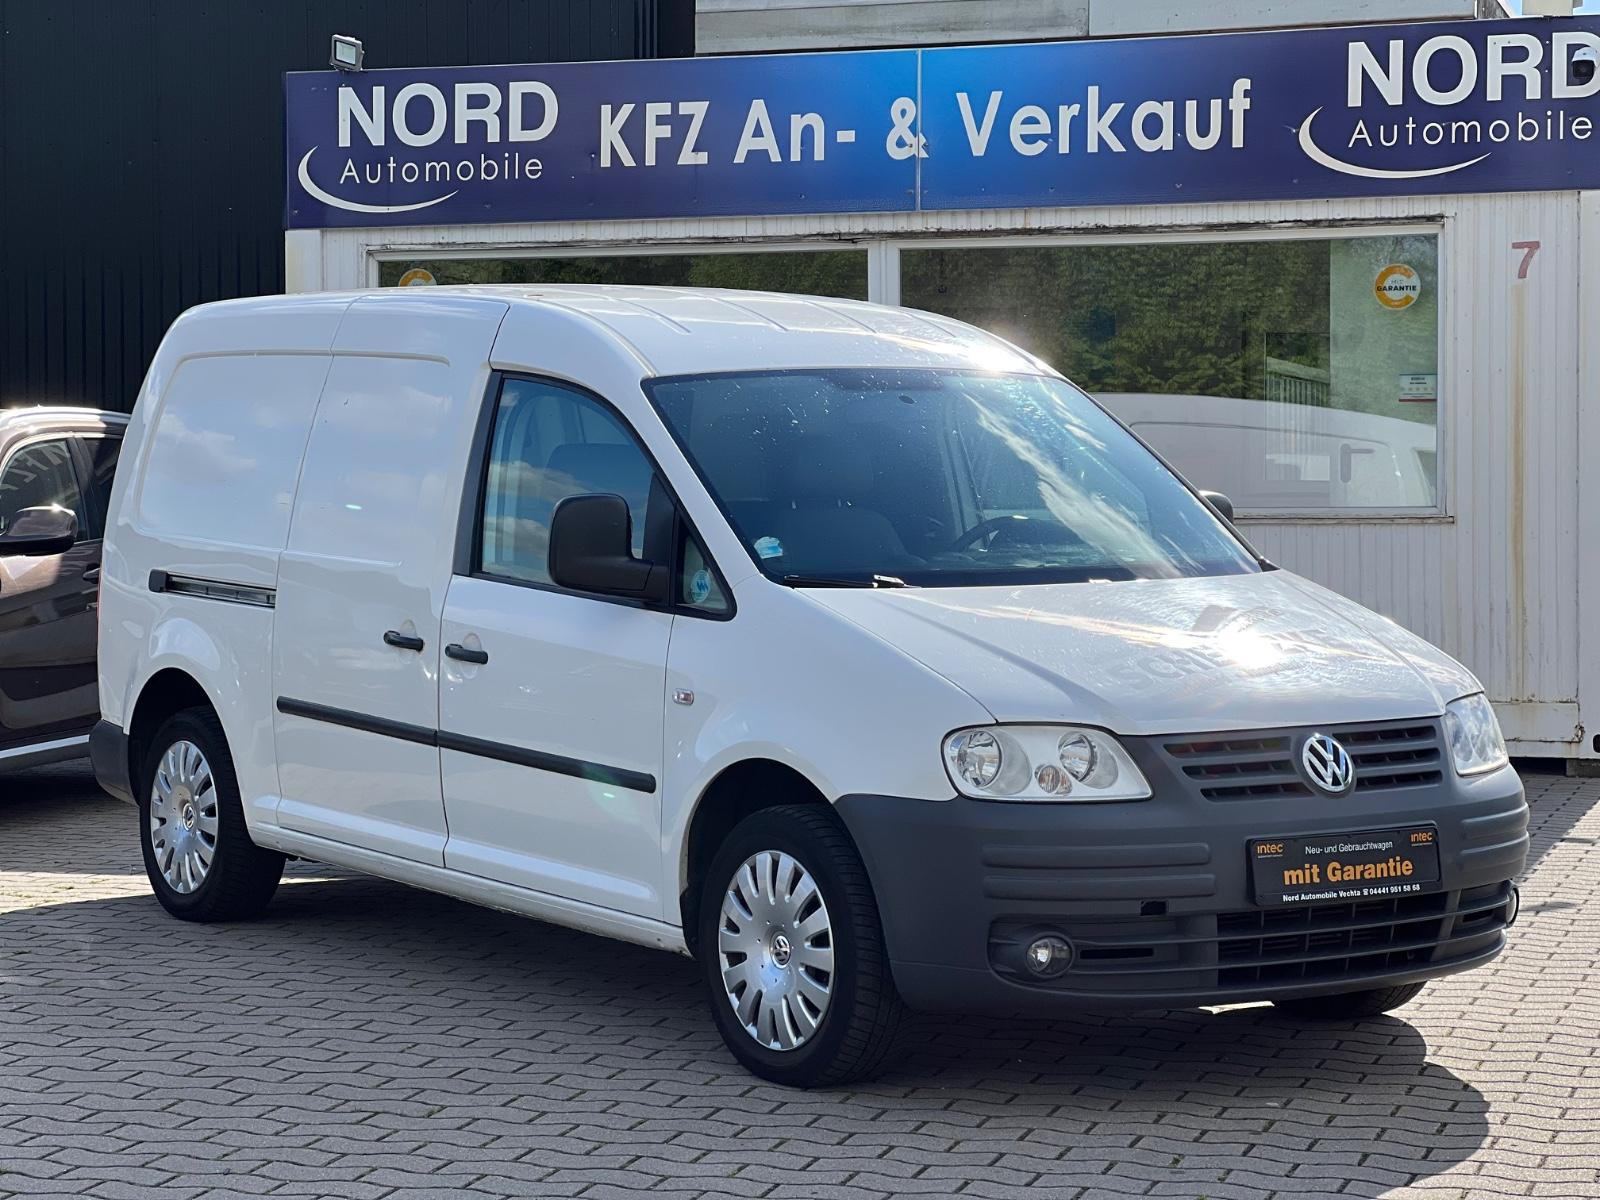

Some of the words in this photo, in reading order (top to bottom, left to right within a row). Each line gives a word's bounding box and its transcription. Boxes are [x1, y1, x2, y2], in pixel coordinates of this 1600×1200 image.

[1348, 32, 1600, 106] NORD
[338, 81, 559, 148] NORD
[600, 101, 710, 168] KFZ
[733, 99, 856, 164] An-
[886, 97, 929, 160] &
[956, 78, 1251, 156] Verkauf
[1348, 110, 1593, 148] Automobile
[339, 152, 543, 184] Automobile
[1512, 241, 1541, 279] 7
[1305, 846, 1323, 855] Neu-
[1324, 844, 1338, 853] und
[1338, 840, 1393, 853] Gebrauchtwagen
[1283, 863, 1321, 886] mit
[1327, 856, 1414, 882] Garantie
[1282, 894, 1300, 902] Nord
[1301, 891, 1338, 901] Automobile
[1338, 889, 1361, 898] Vechta
[1369, 886, 1389, 895] 04441
